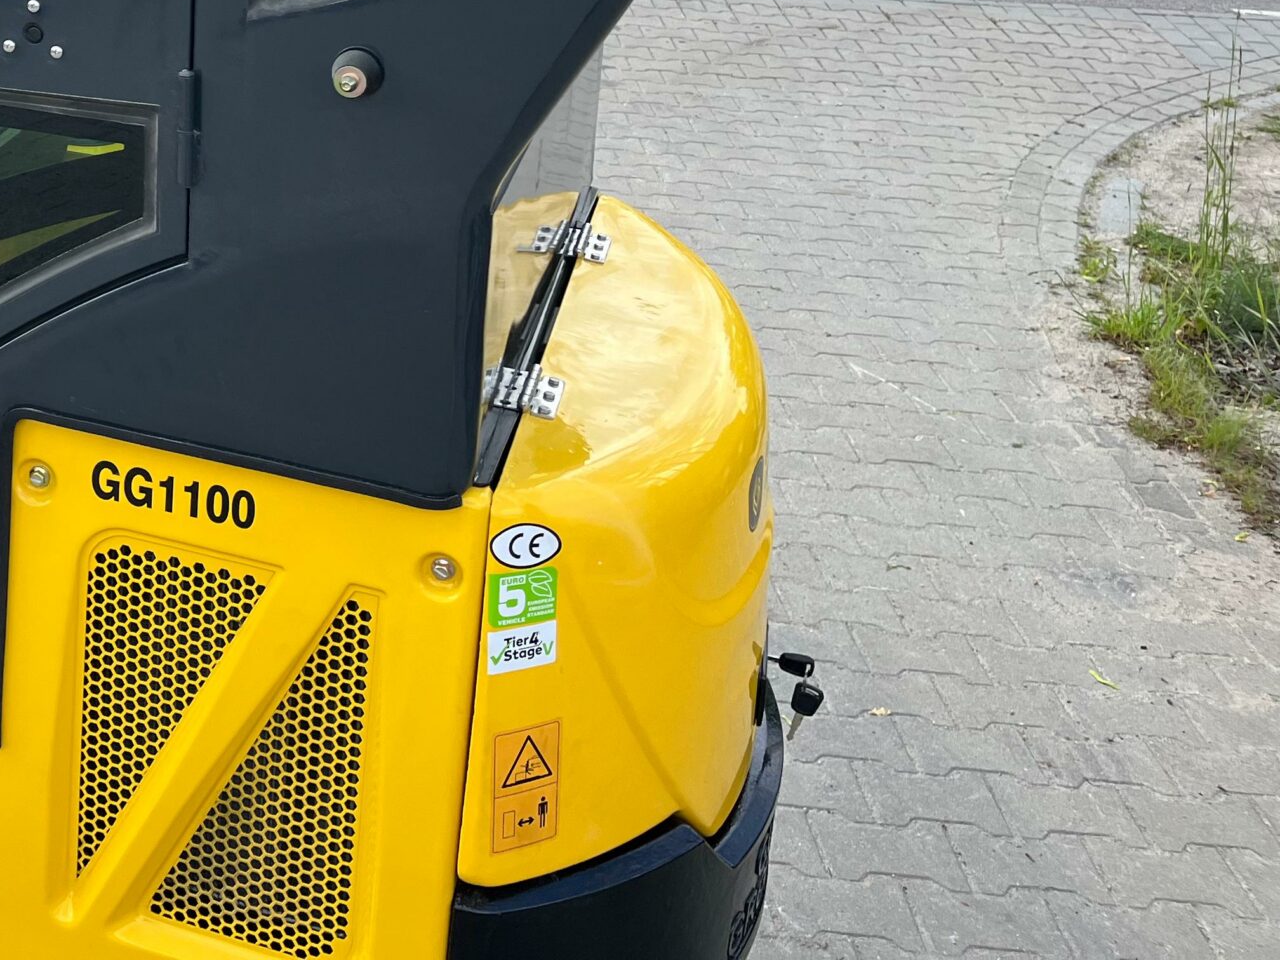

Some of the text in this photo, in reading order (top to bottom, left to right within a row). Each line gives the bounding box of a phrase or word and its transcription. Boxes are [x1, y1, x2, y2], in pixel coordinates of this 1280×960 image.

[91, 460, 256, 529] GG1100
[509, 533, 544, 559] CE
[501, 576, 524, 585] EURO
[498, 617, 526, 626] VEHICLE
[504, 646, 542, 661] Stage
